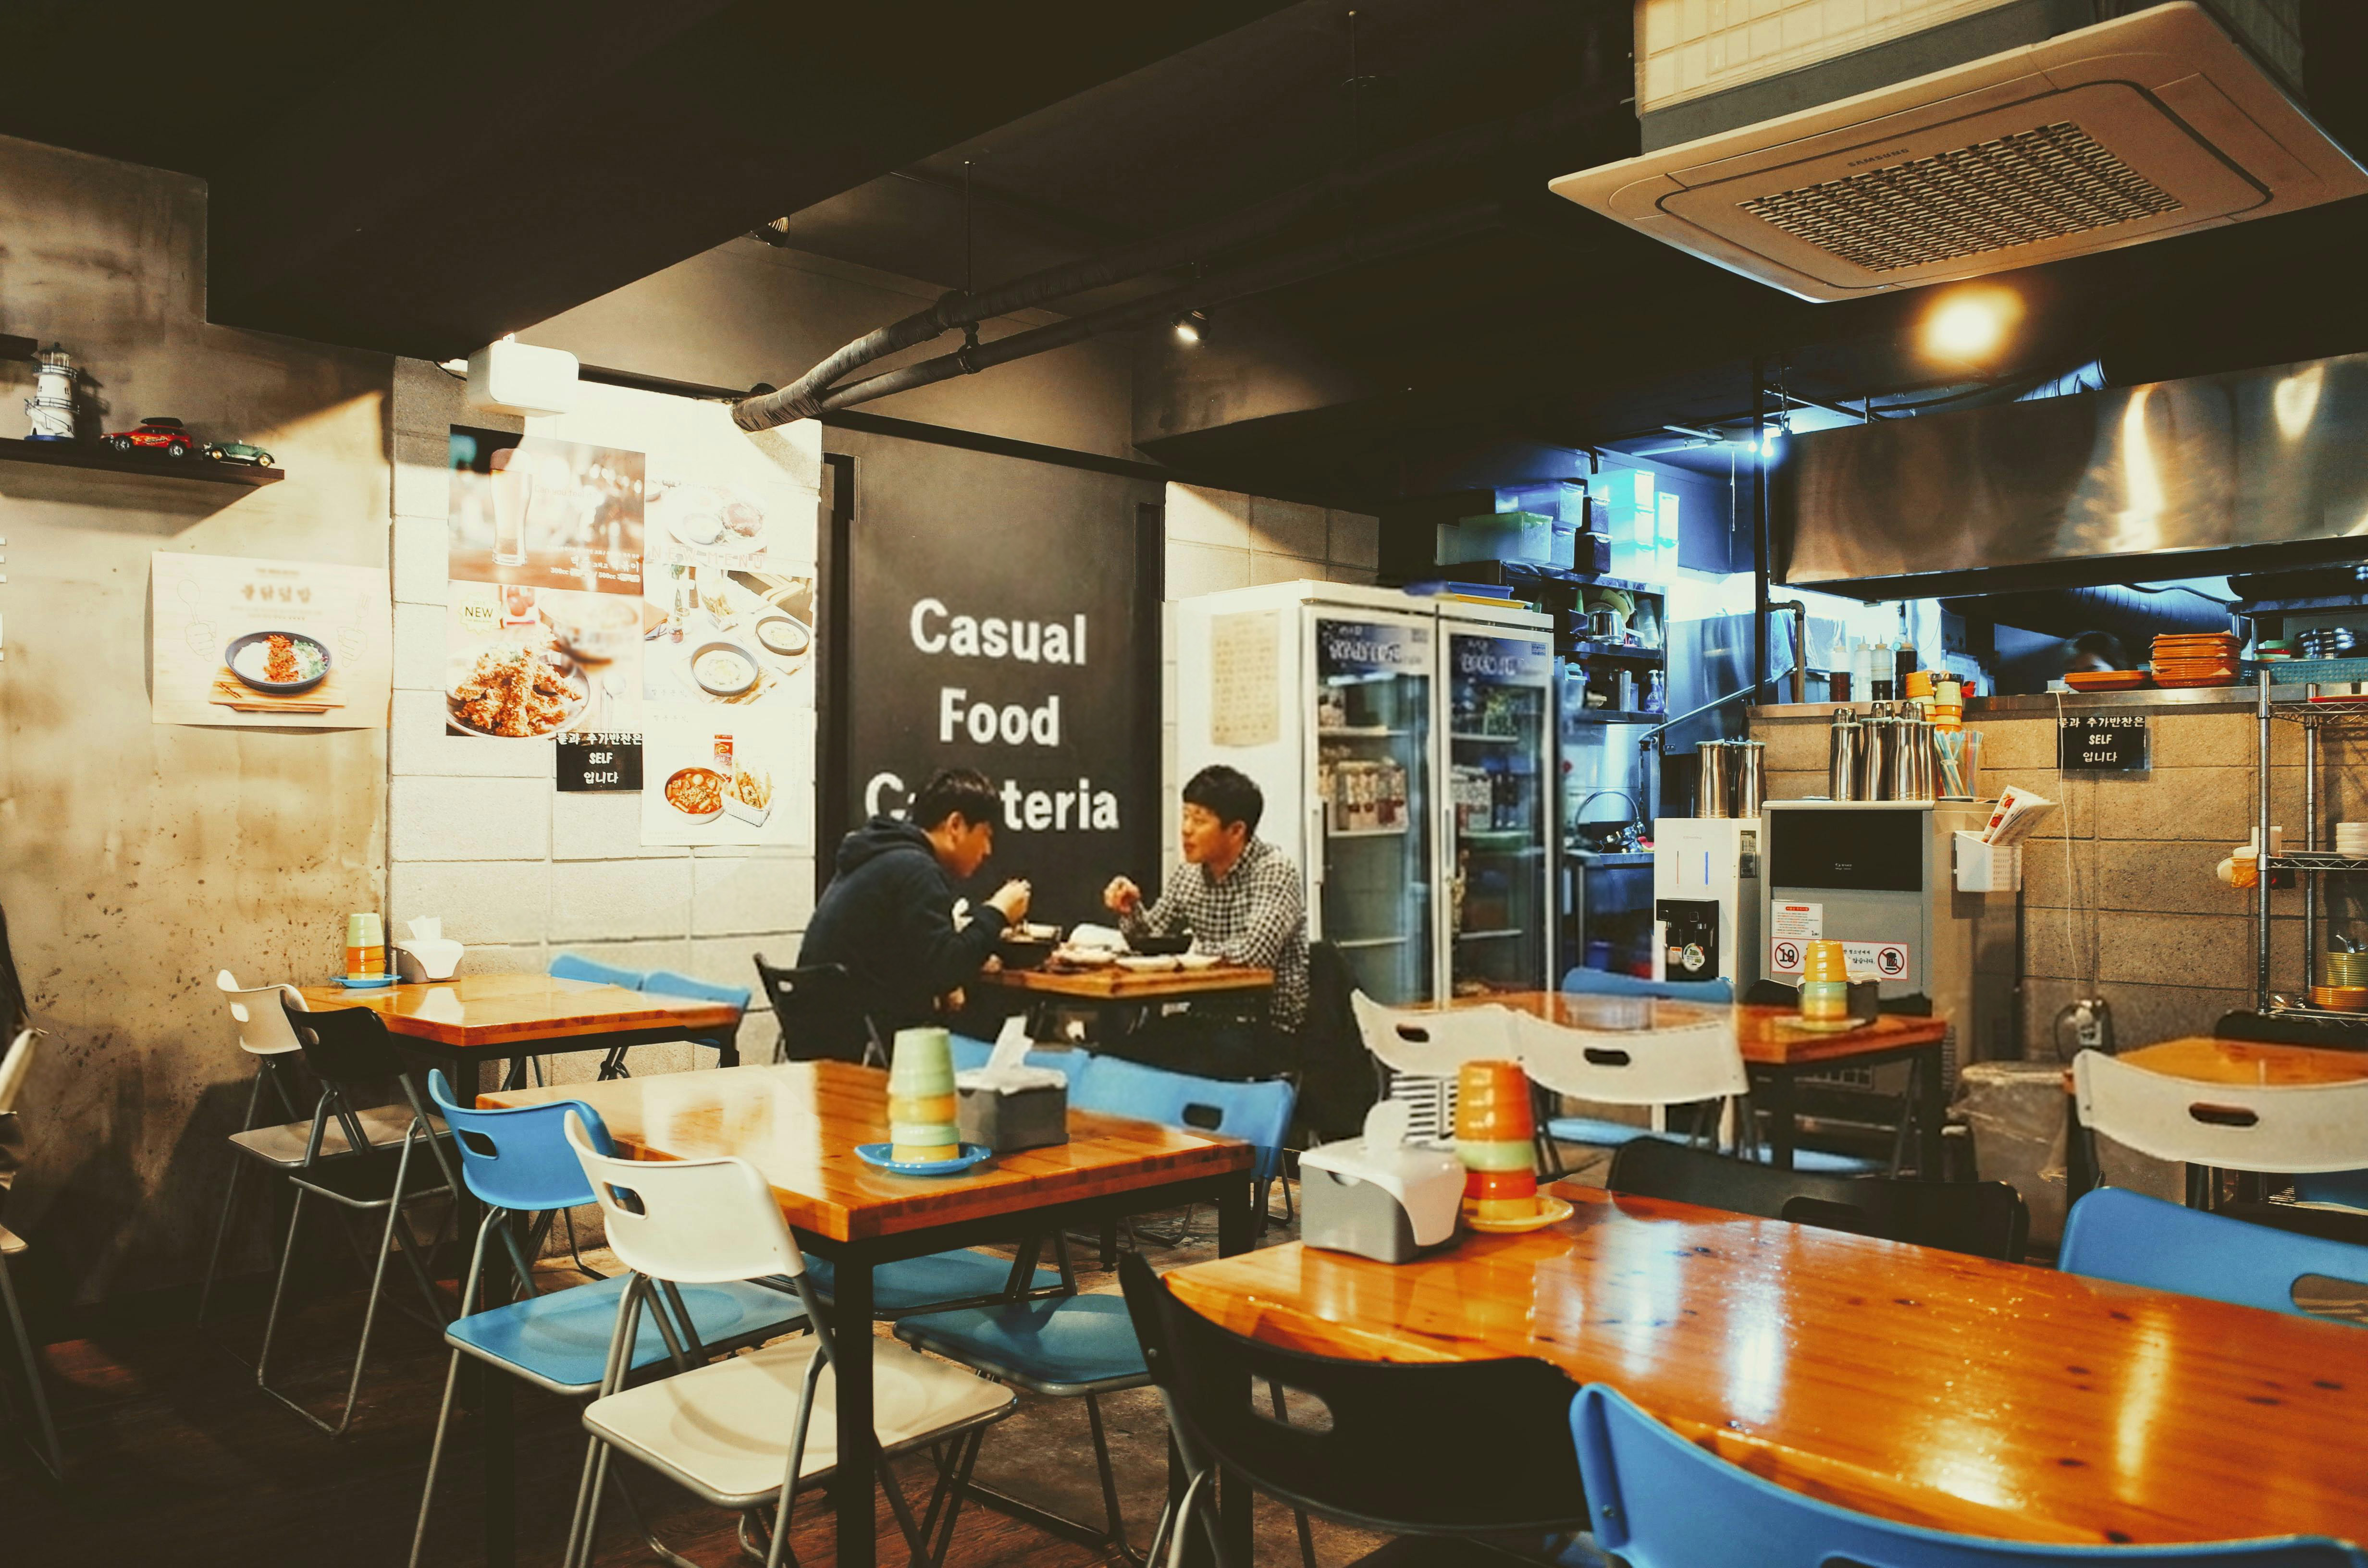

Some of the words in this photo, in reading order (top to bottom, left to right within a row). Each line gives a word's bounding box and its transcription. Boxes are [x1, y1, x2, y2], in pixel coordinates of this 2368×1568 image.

[1847, 148, 1910, 167] SAMSUNG
[651, 546, 697, 562] NEW
[707, 551, 765, 569] MENU
[465, 606, 493, 618] NEW
[910, 598, 1086, 665] Casual
[939, 687, 1060, 747] Food
[2086, 716, 2145, 728] 추가반찬은
[586, 733, 642, 745] 추가반찬은
[2088, 734, 2113, 745] SELF
[589, 752, 613, 765] SELF
[2083, 751, 2118, 762] 입니다
[583, 771, 619, 784] 입니다
[865, 772, 1120, 831] Cteria
[1779, 949, 1795, 963] 19
